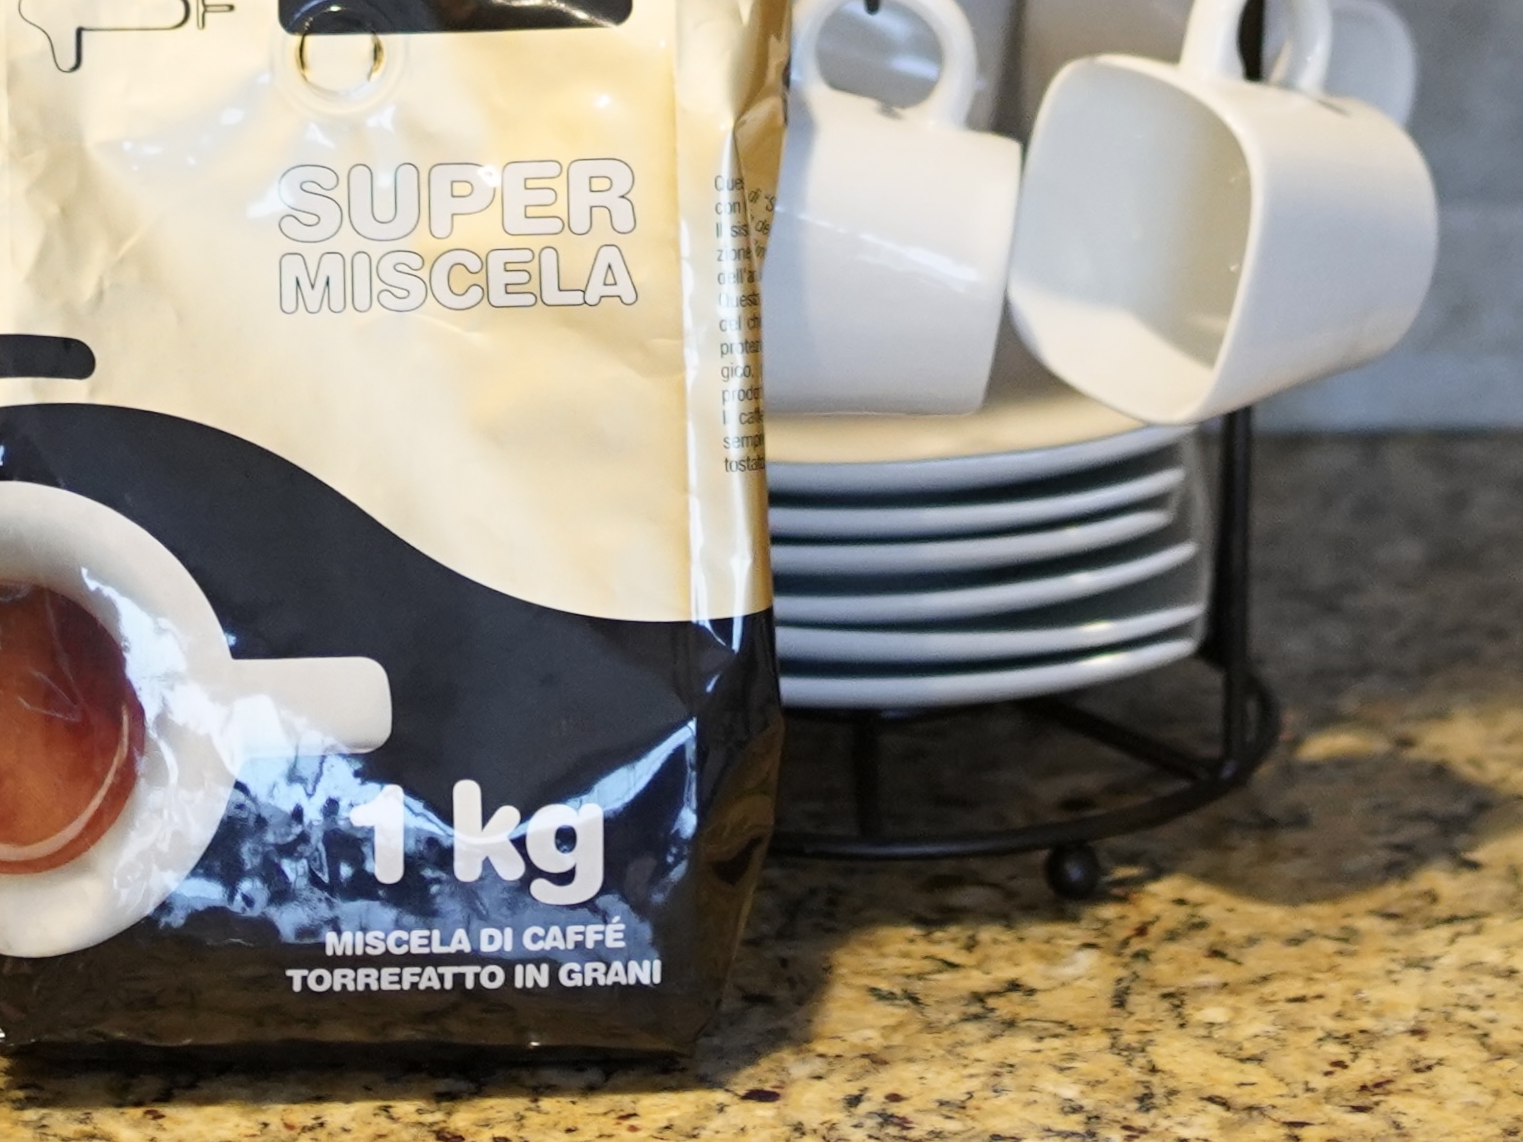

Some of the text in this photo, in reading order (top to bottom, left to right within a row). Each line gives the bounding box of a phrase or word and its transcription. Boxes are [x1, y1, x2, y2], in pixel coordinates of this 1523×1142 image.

[278, 157, 637, 244] SUPER
[715, 201, 741, 215] con
[279, 244, 639, 315] MISCELA
[349, 778, 605, 906] 1 kg
[325, 915, 626, 957] MISCELA DI CAFFÉ
[285, 959, 662, 993] TORREFATTO IN GRANI
